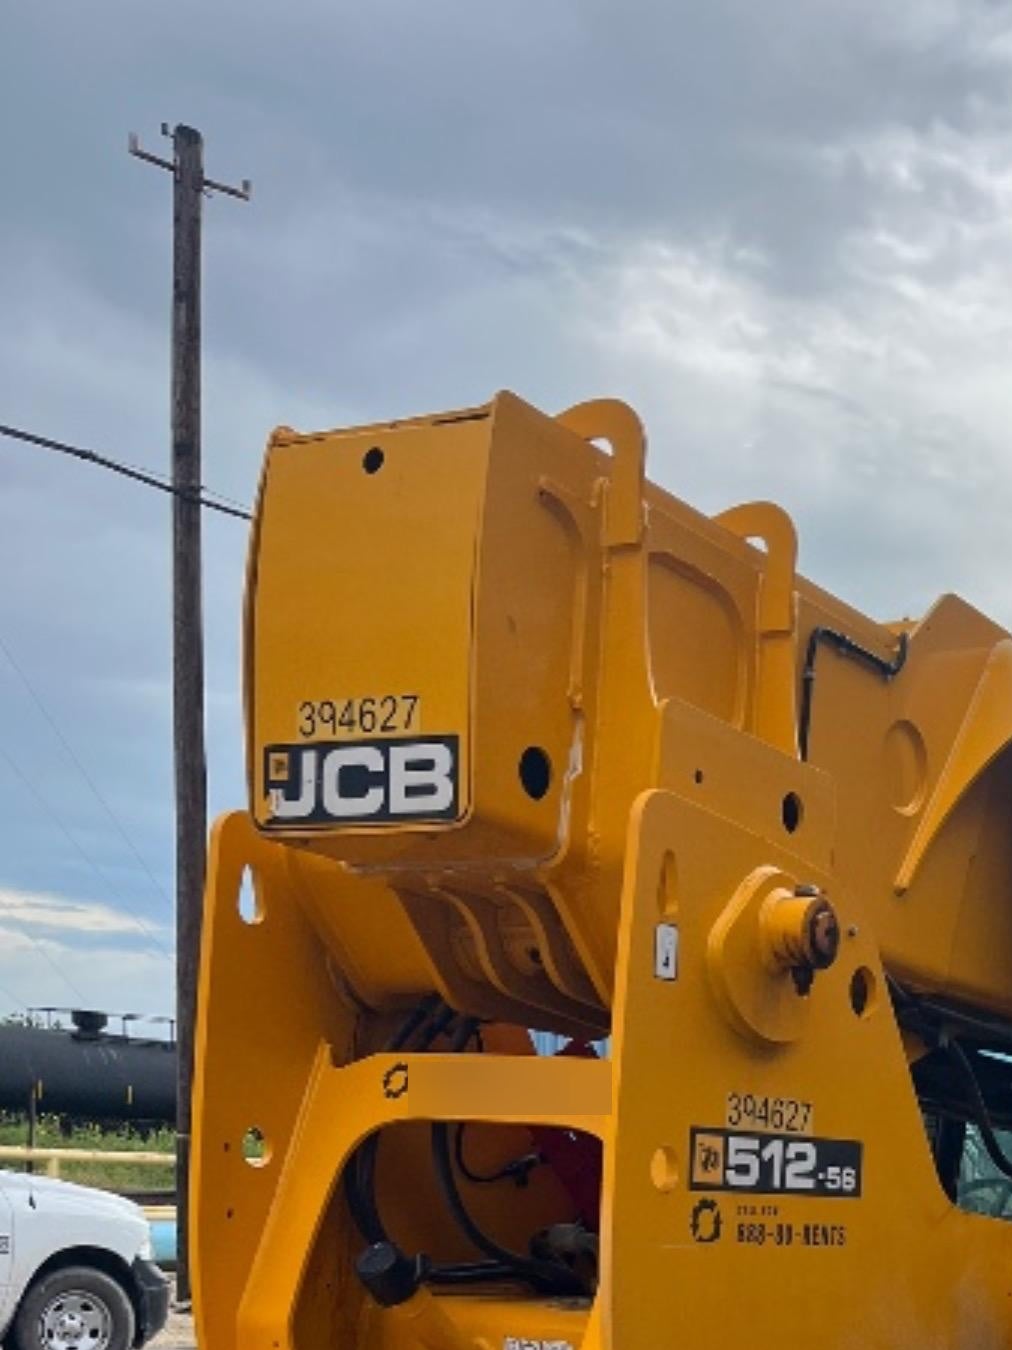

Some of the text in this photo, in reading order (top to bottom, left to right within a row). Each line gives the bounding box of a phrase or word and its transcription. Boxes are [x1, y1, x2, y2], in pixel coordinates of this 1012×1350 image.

[298, 694, 418, 737] 394627
[267, 742, 454, 817] JCB
[727, 1092, 812, 1132] 394627
